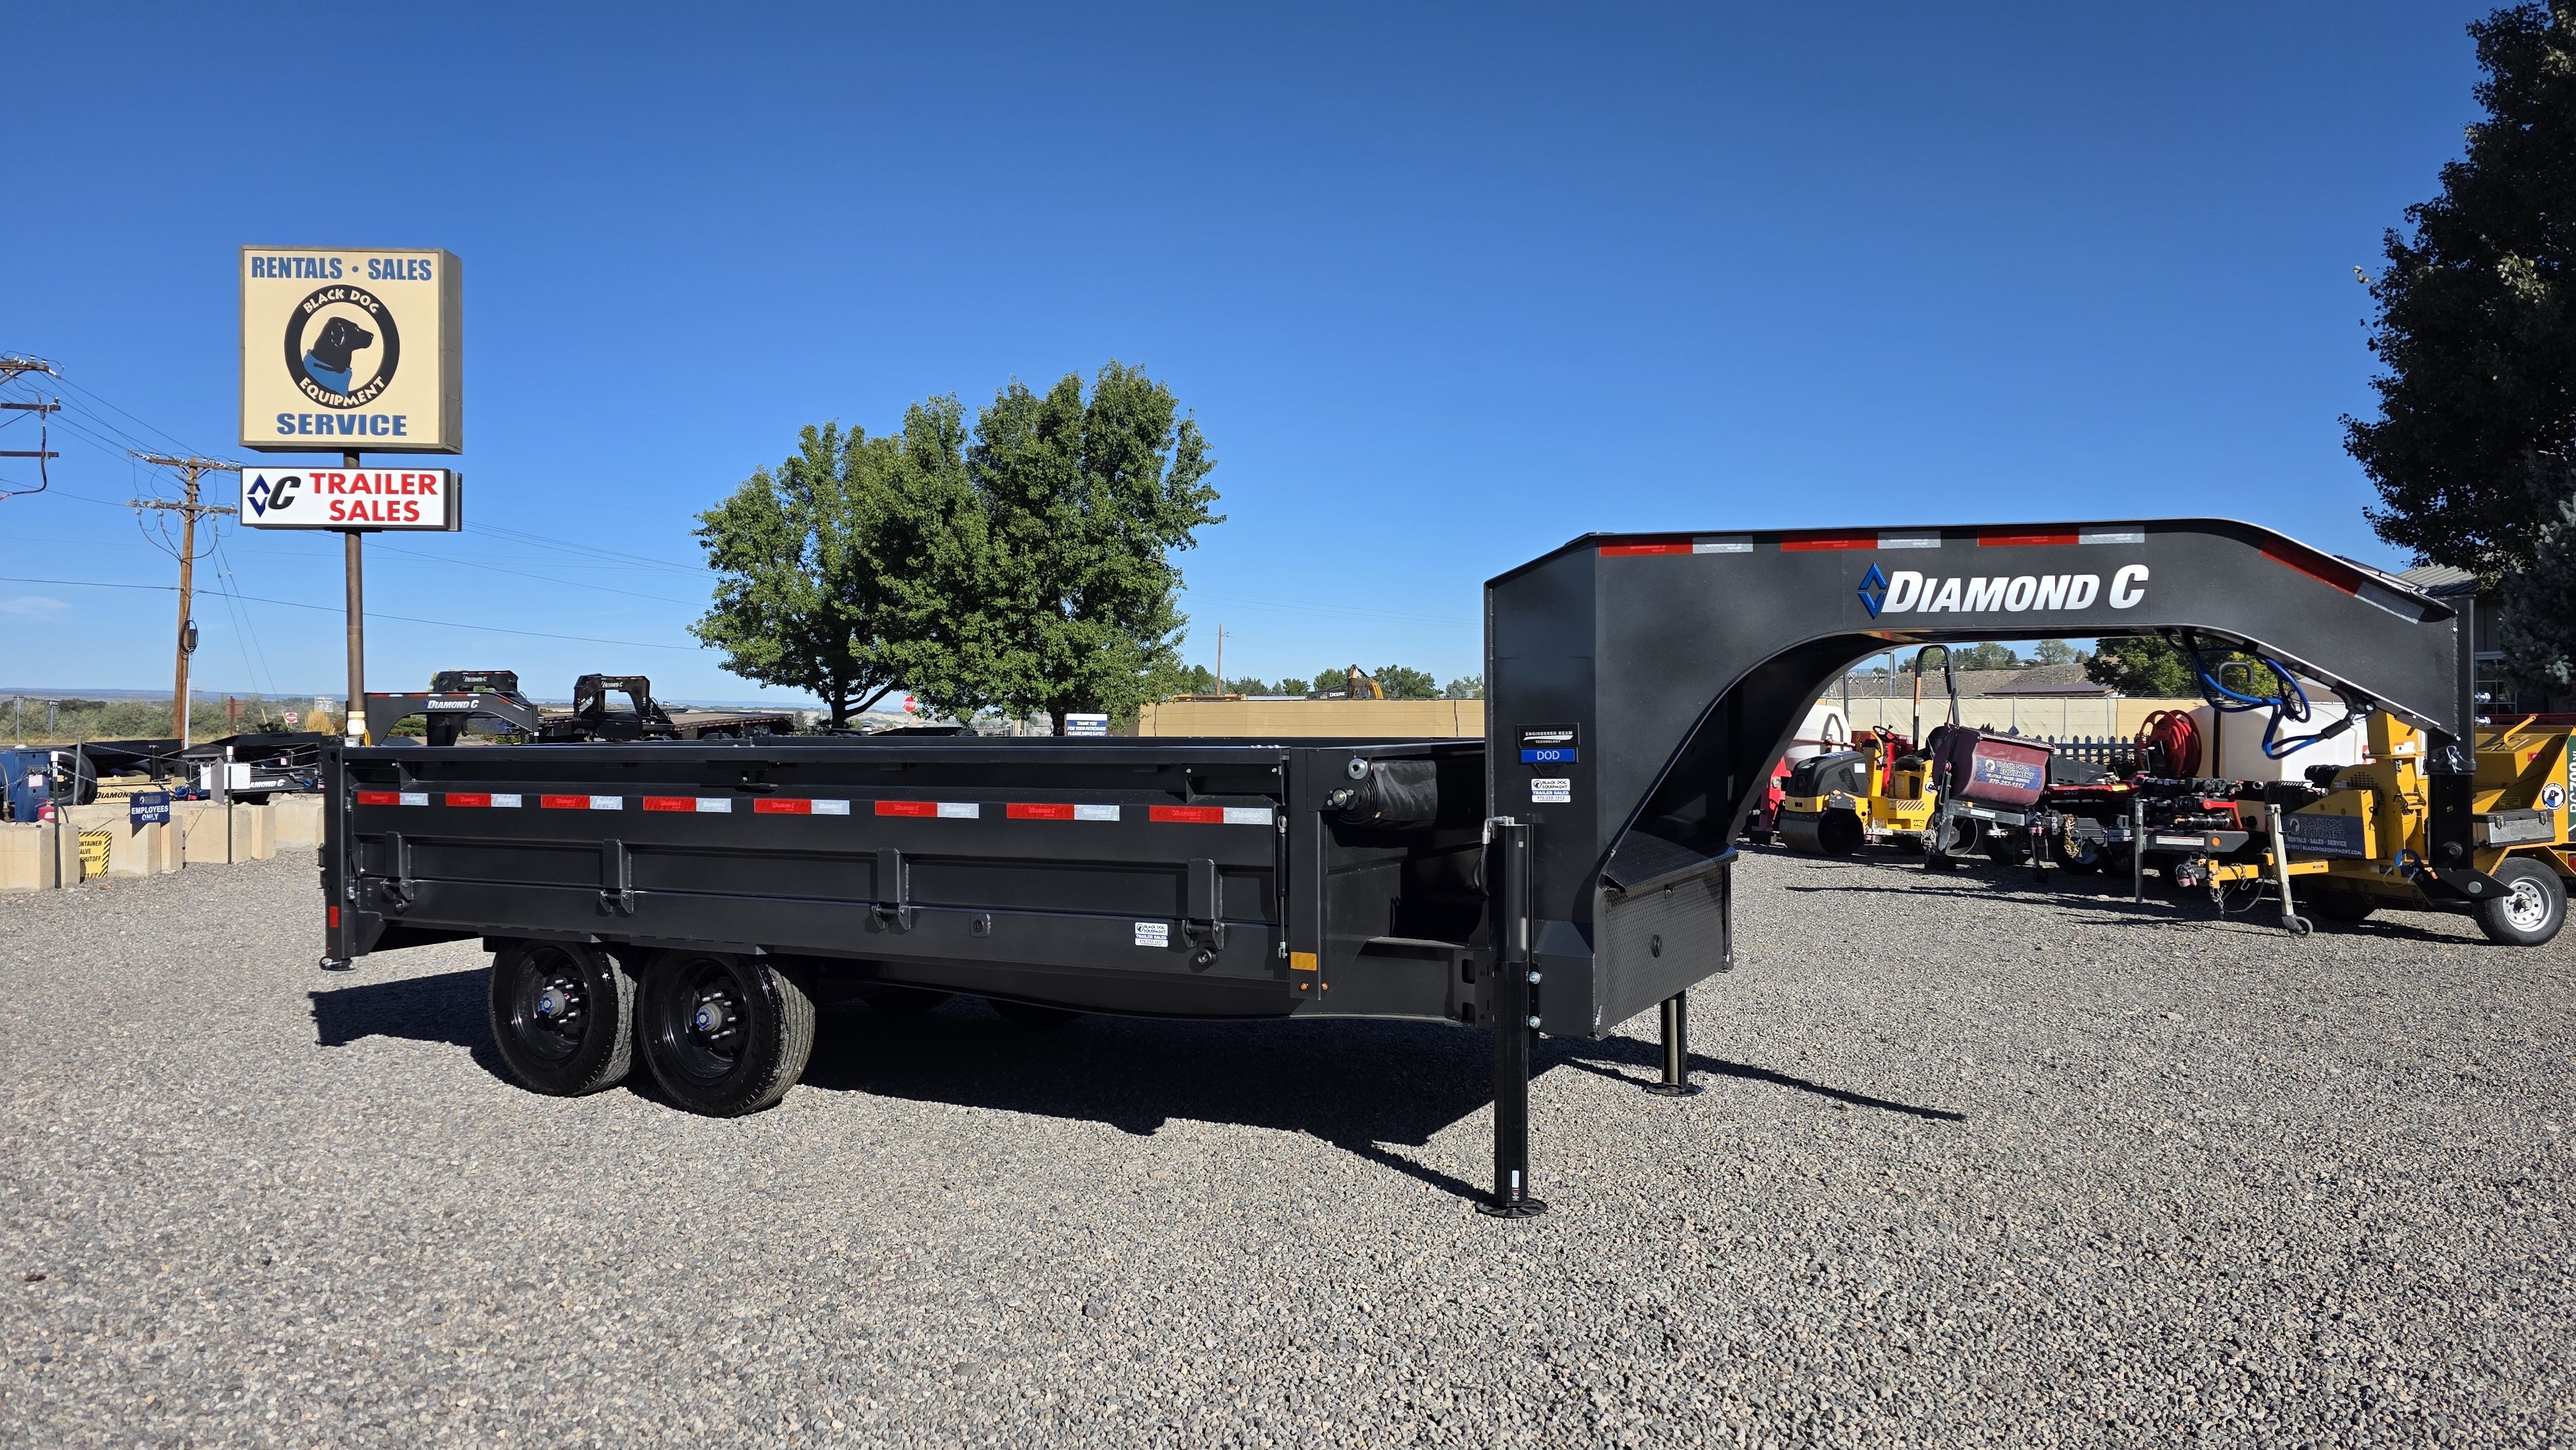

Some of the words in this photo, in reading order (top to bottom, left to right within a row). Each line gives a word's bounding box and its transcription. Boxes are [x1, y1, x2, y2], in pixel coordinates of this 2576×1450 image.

[251, 256, 343, 279] RENTALS
[368, 258, 432, 281] SALES
[303, 288, 345, 314] BLACK
[350, 290, 379, 314] DOG
[299, 376, 386, 407] EQUIPMENT
[276, 413, 407, 437] SERVICE
[309, 473, 439, 496] TRAILER
[268, 476, 301, 510] C
[329, 500, 420, 522] SALES
[1880, 570, 2100, 613] DIAMOND
[2108, 564, 2150, 609] C
[427, 700, 470, 709] DIAMOND
[470, 699, 480, 709] C
[1537, 750, 1560, 760] DOD
[1996, 760, 2016, 769] BLACK
[2000, 768, 2035, 779] EQUIPMENT
[277, 778, 286, 787] C
[1989, 778, 2025, 789] 970-252-1512
[131, 805, 169, 814] EMPLOYEES
[142, 813, 159, 821] ONLY
[2300, 817, 2324, 828] BLACK
[2325, 818, 2344, 829] DOG
[2302, 827, 2345, 839] EQUIPMENT
[2327, 839, 2347, 847] SERVICE
[2302, 845, 2362, 856] BLACKDOGEQUIPMENT.COM
